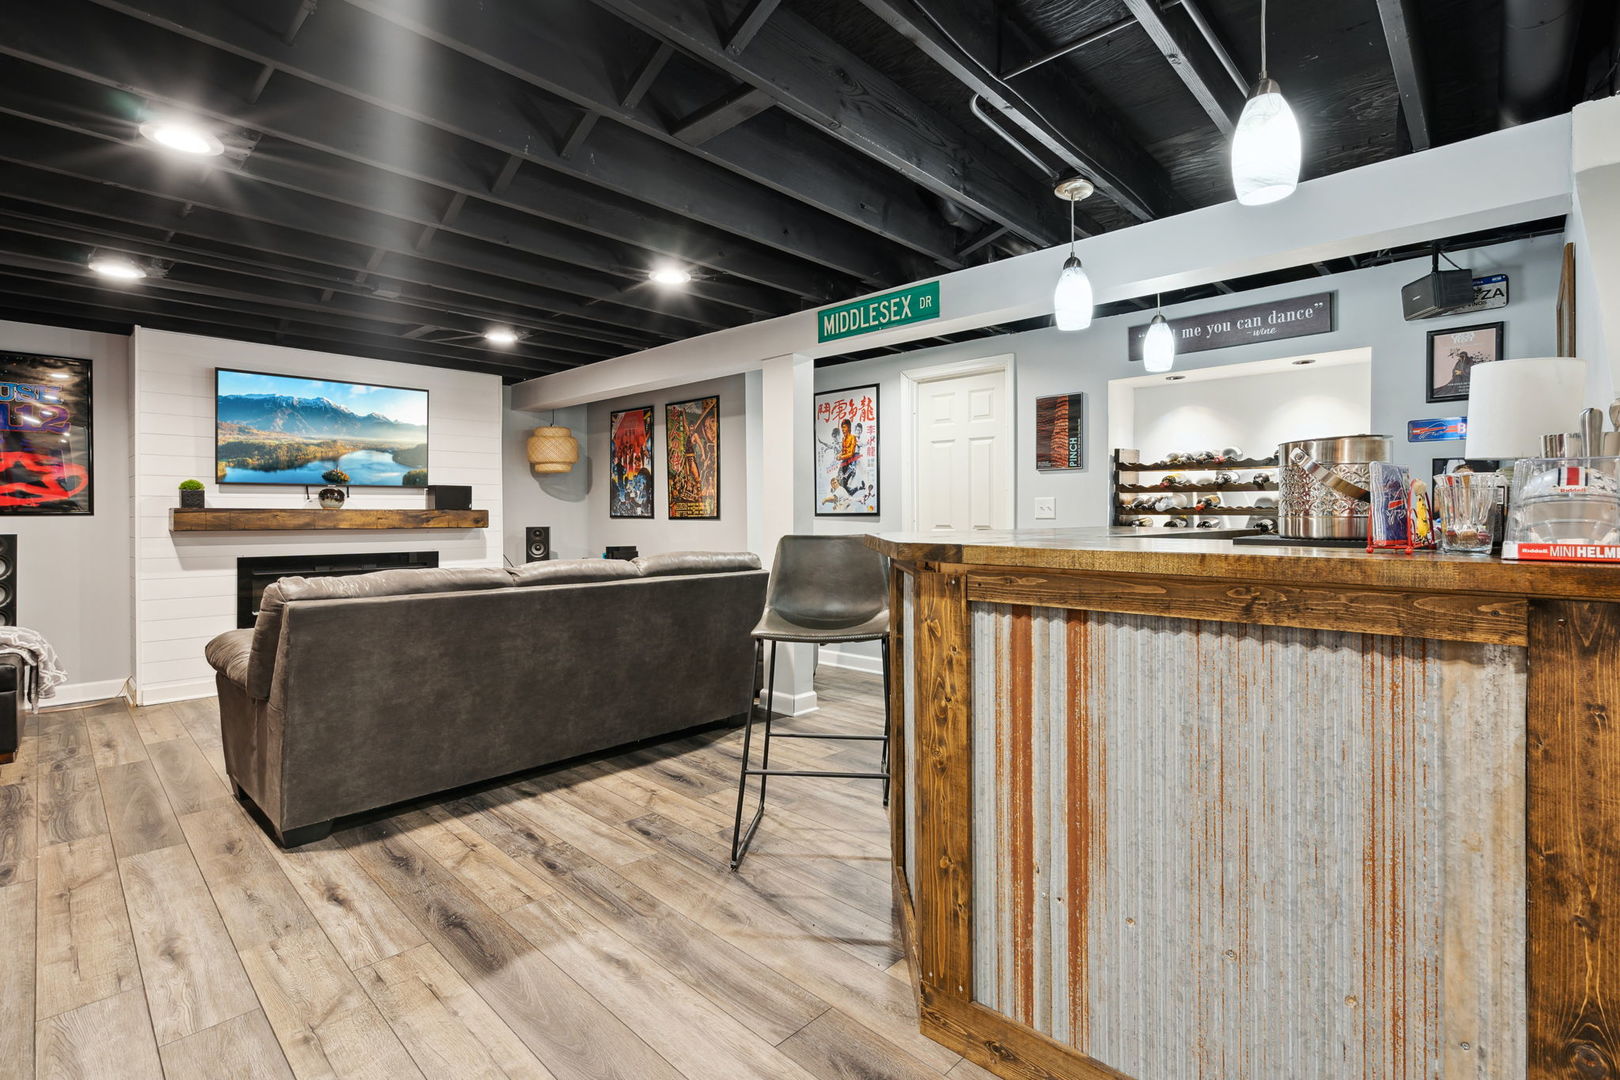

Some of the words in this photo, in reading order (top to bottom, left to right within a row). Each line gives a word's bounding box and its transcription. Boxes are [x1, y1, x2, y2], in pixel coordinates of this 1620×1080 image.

[823, 294, 912, 336] MIDDLESEX
[919, 295, 932, 309] DR
[1182, 323, 1201, 339] me
[1206, 321, 1231, 339] you
[1237, 316, 1262, 330] can
[1069, 437, 1078, 467] PINCH
[1549, 545, 1575, 558] MINI
